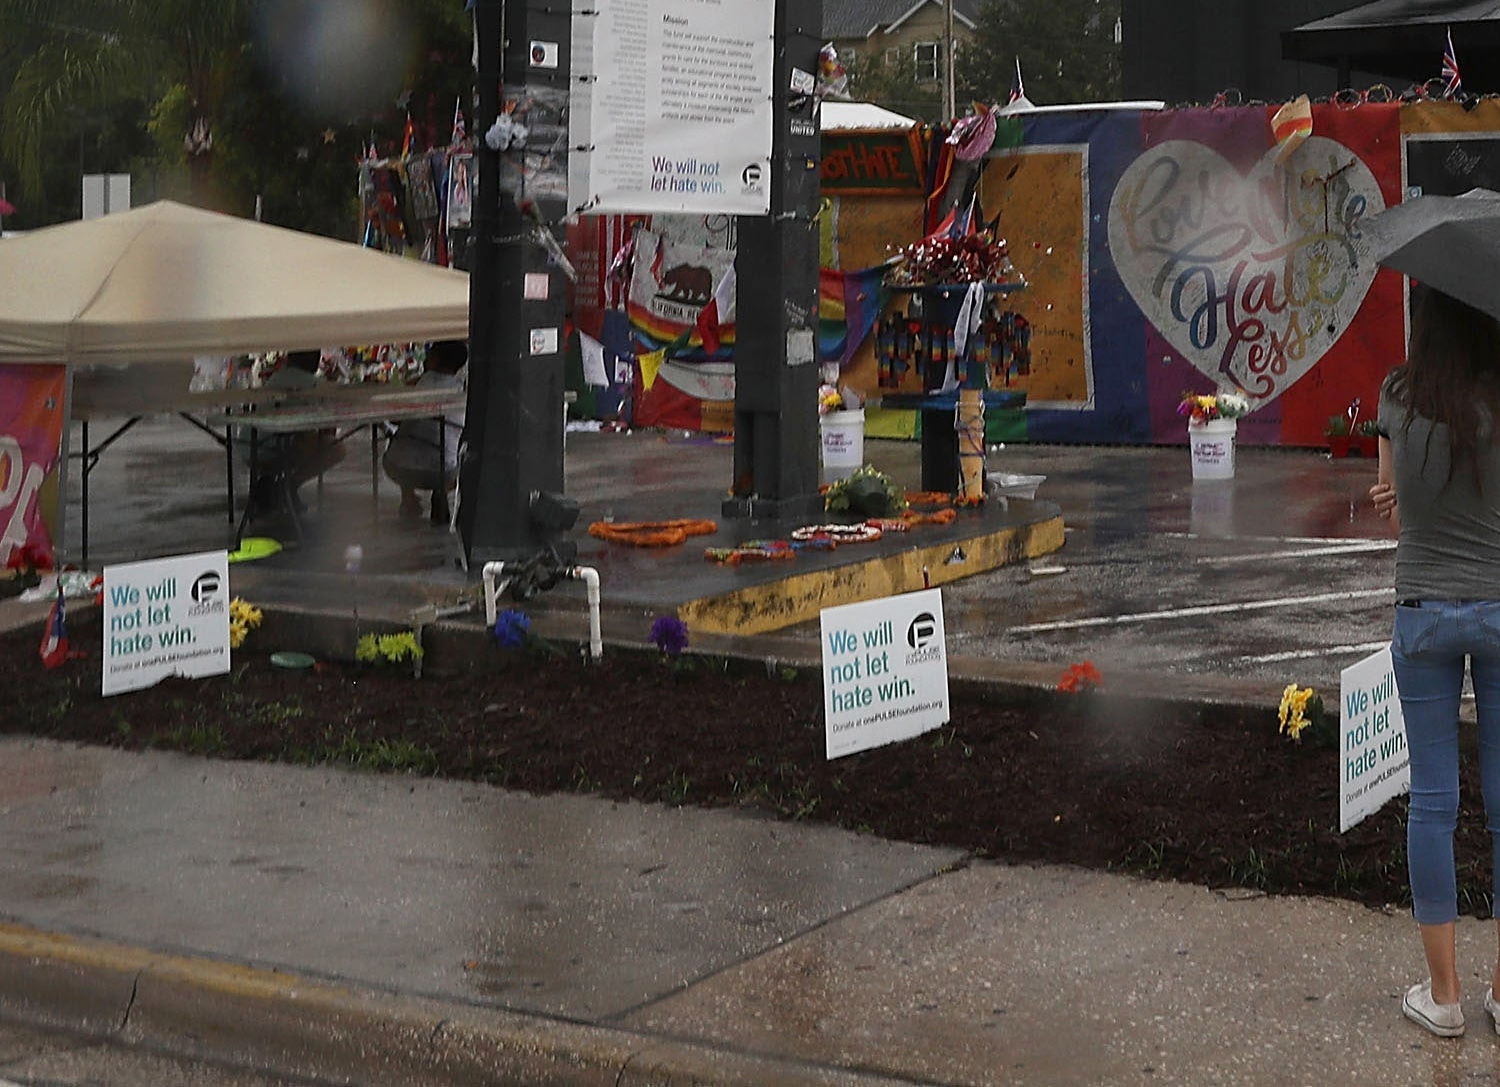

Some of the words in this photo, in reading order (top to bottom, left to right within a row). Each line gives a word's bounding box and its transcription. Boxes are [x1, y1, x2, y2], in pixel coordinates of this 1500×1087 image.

[663, 14, 688, 25] Mission
[652, 156, 672, 173] We
[676, 158, 696, 175] will
[700, 161, 719, 176] not
[651, 175, 667, 192] let
[670, 175, 697, 193] hate
[701, 178, 726, 194] win.
[1170, 248, 1348, 351] Hate
[1218, 318, 1316, 388] Less
[111, 584, 140, 607] We
[146, 577, 176, 602] will
[111, 608, 142, 632] not
[148, 603, 170, 626] let
[110, 633, 153, 657] hate
[159, 624, 196, 648] win.
[829, 629, 857, 656] We
[863, 620, 892, 648] will
[831, 656, 861, 684] not
[866, 651, 889, 677] let
[832, 684, 872, 714] hate
[878, 675, 915, 701] win.
[1346, 688, 1368, 720] We
[1372, 671, 1393, 706] will
[833, 719, 855, 733] Donate
[856, 718, 862, 727] at
[863, 700, 943, 725] onePULSEfoundation.org
[1346, 717, 1369, 752] not
[1373, 705, 1389, 735] let
[1346, 747, 1376, 783] hate
[1380, 730, 1406, 762] win.
[1346, 784, 1363, 804] Donate
